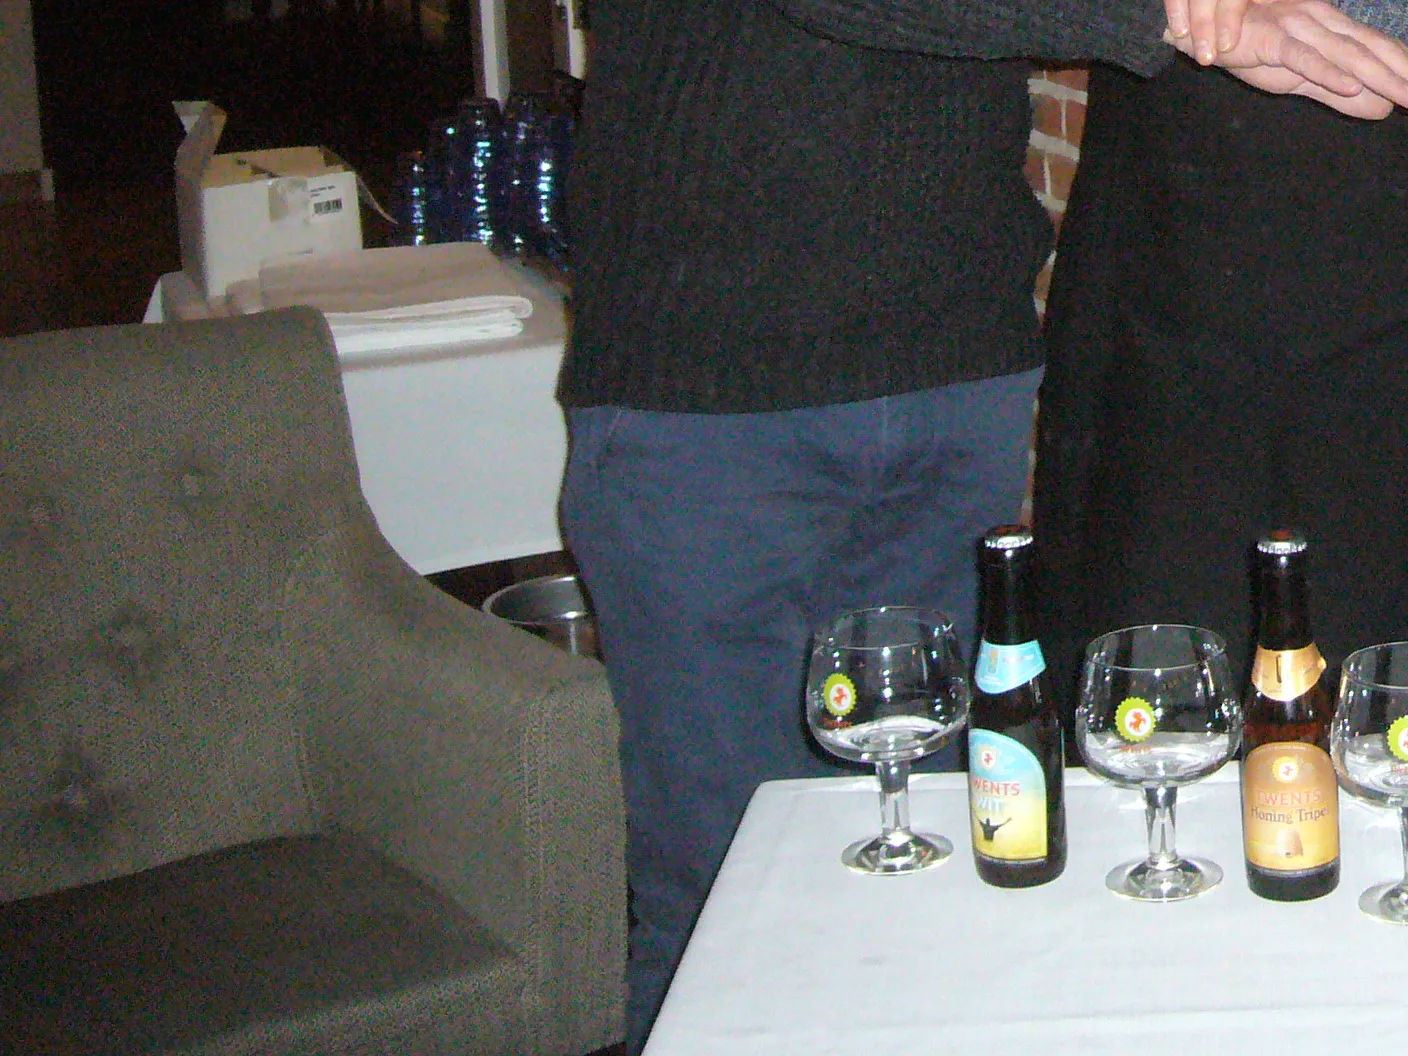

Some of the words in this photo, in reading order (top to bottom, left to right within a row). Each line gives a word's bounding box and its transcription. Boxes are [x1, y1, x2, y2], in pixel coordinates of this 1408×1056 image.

[972, 778, 1020, 796] WENTS
[1255, 789, 1322, 806] TWENTS
[1251, 804, 1294, 825] Honing
